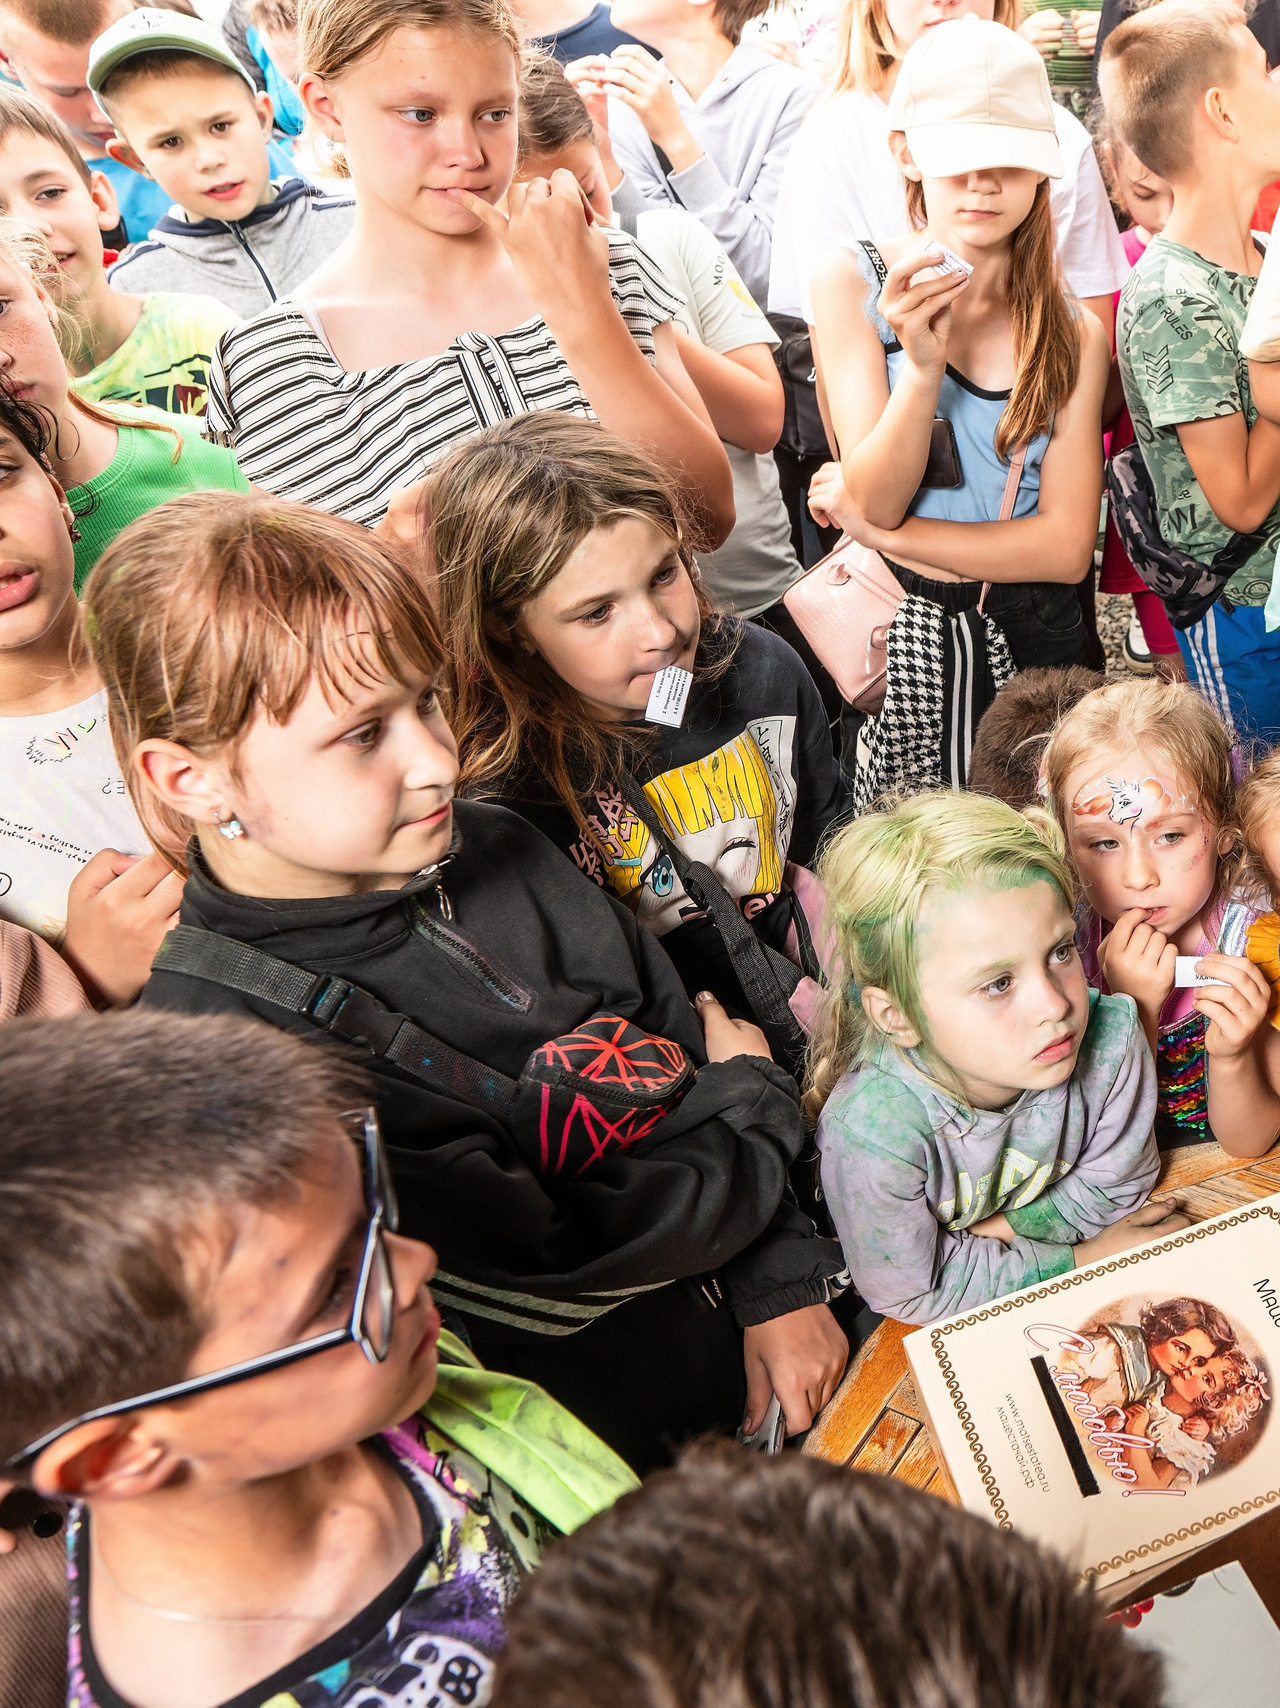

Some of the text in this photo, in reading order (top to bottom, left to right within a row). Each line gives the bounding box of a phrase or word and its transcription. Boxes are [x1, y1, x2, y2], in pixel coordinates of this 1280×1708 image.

[1161, 308, 1193, 341] RULES
[996, 1406, 1034, 1489] мацестачай.рф
[1005, 1393, 1050, 1493] www.matsestatea.ru
